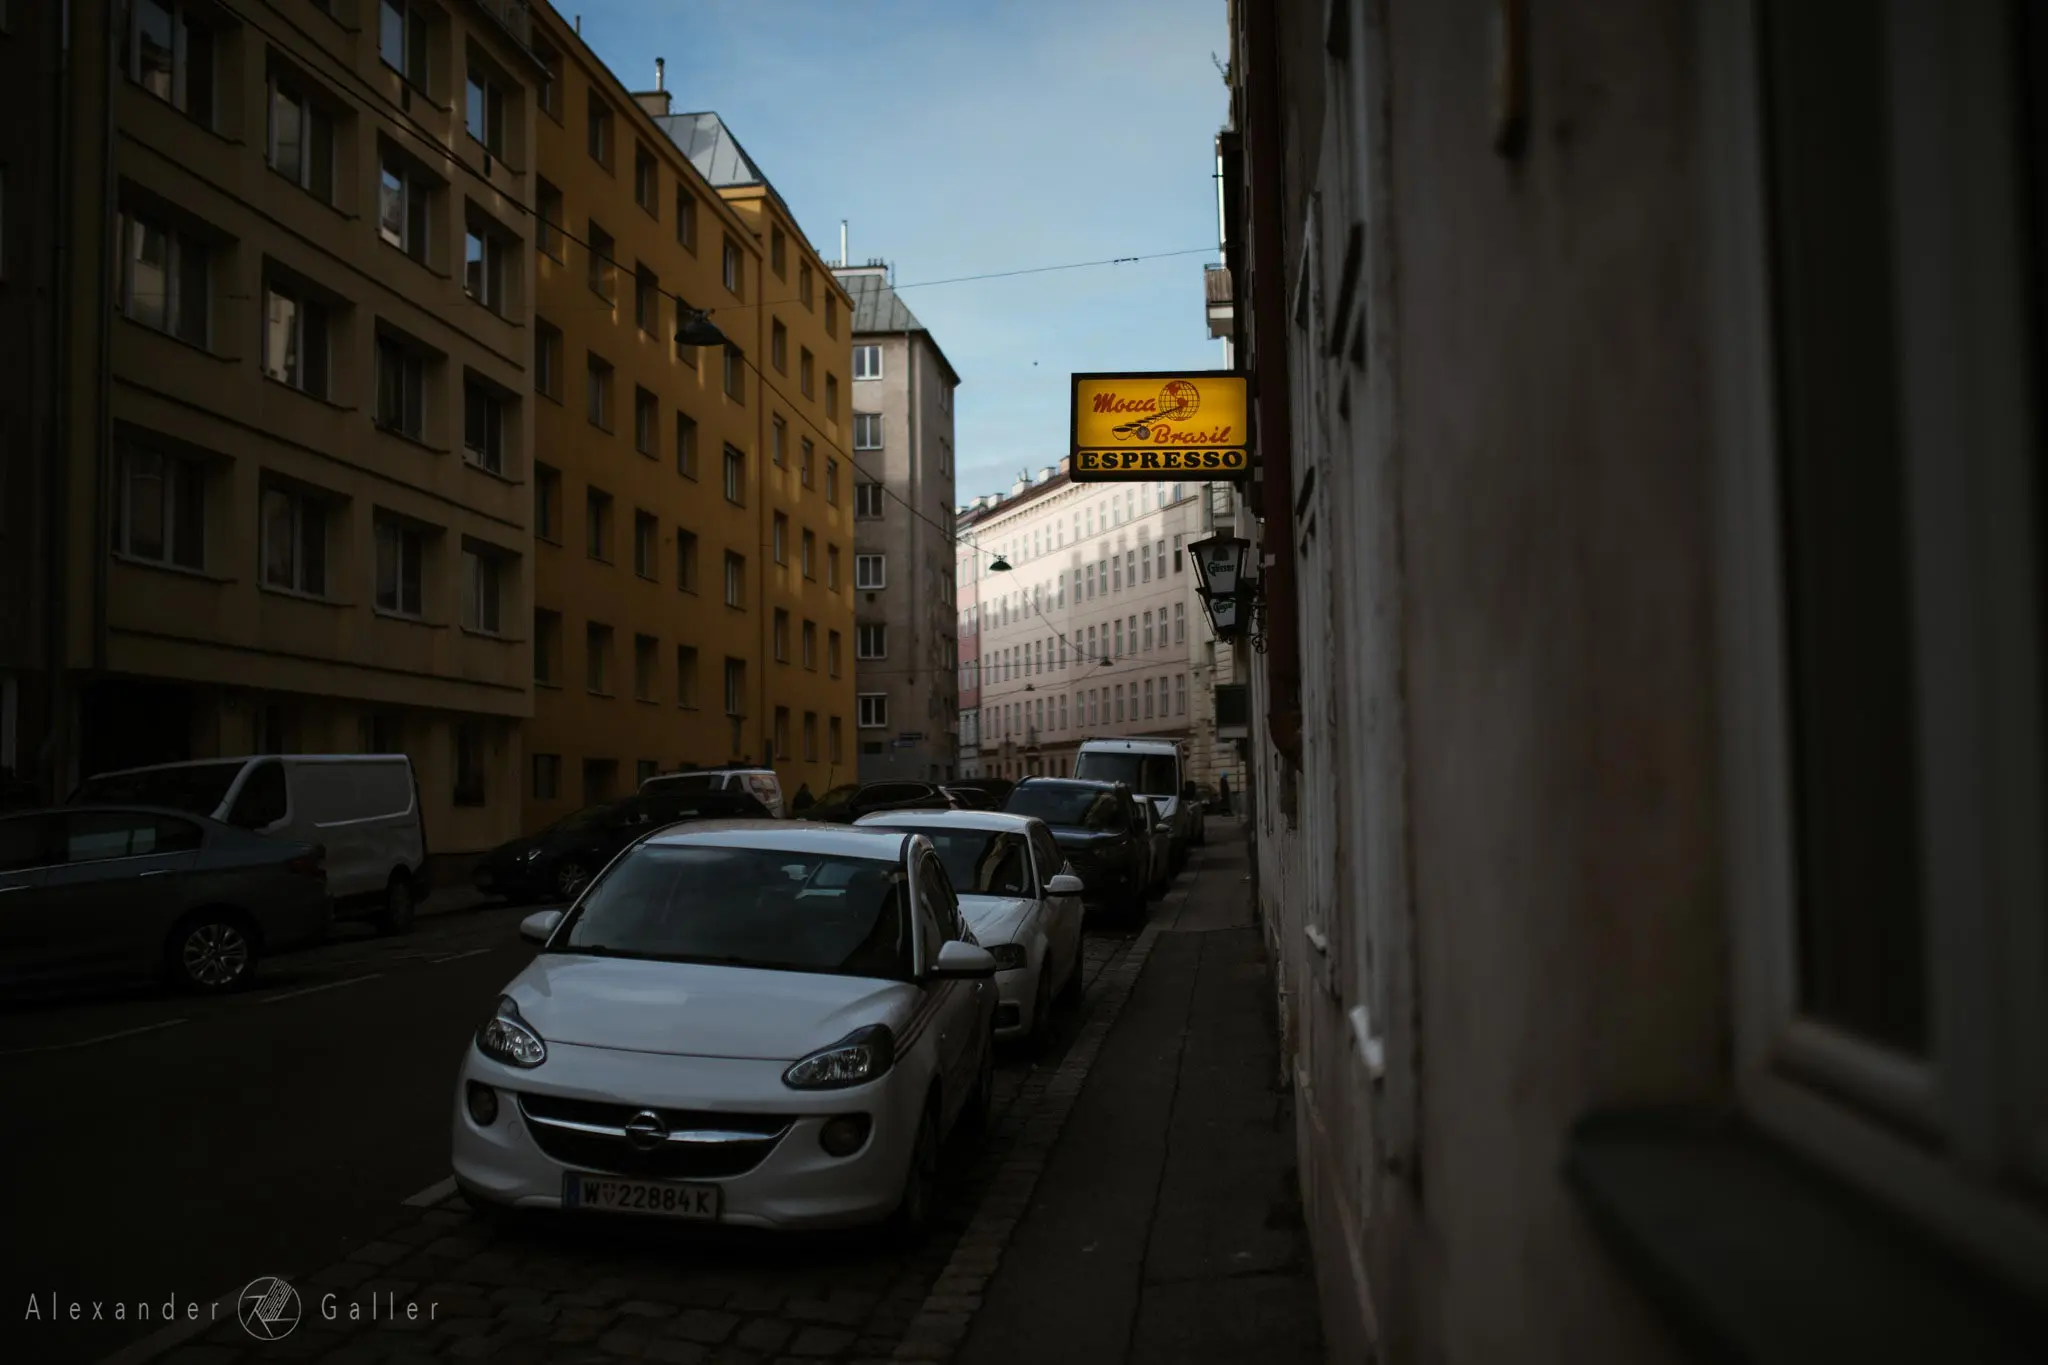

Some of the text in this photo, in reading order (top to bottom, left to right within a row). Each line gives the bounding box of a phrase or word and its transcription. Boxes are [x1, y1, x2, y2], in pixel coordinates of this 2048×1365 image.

[1093, 392, 1156, 413] Mocca
[1151, 423, 1232, 444] Brasil
[1080, 451, 1243, 469] ESPRESSO
[585, 1182, 709, 1213] W 22884 K
